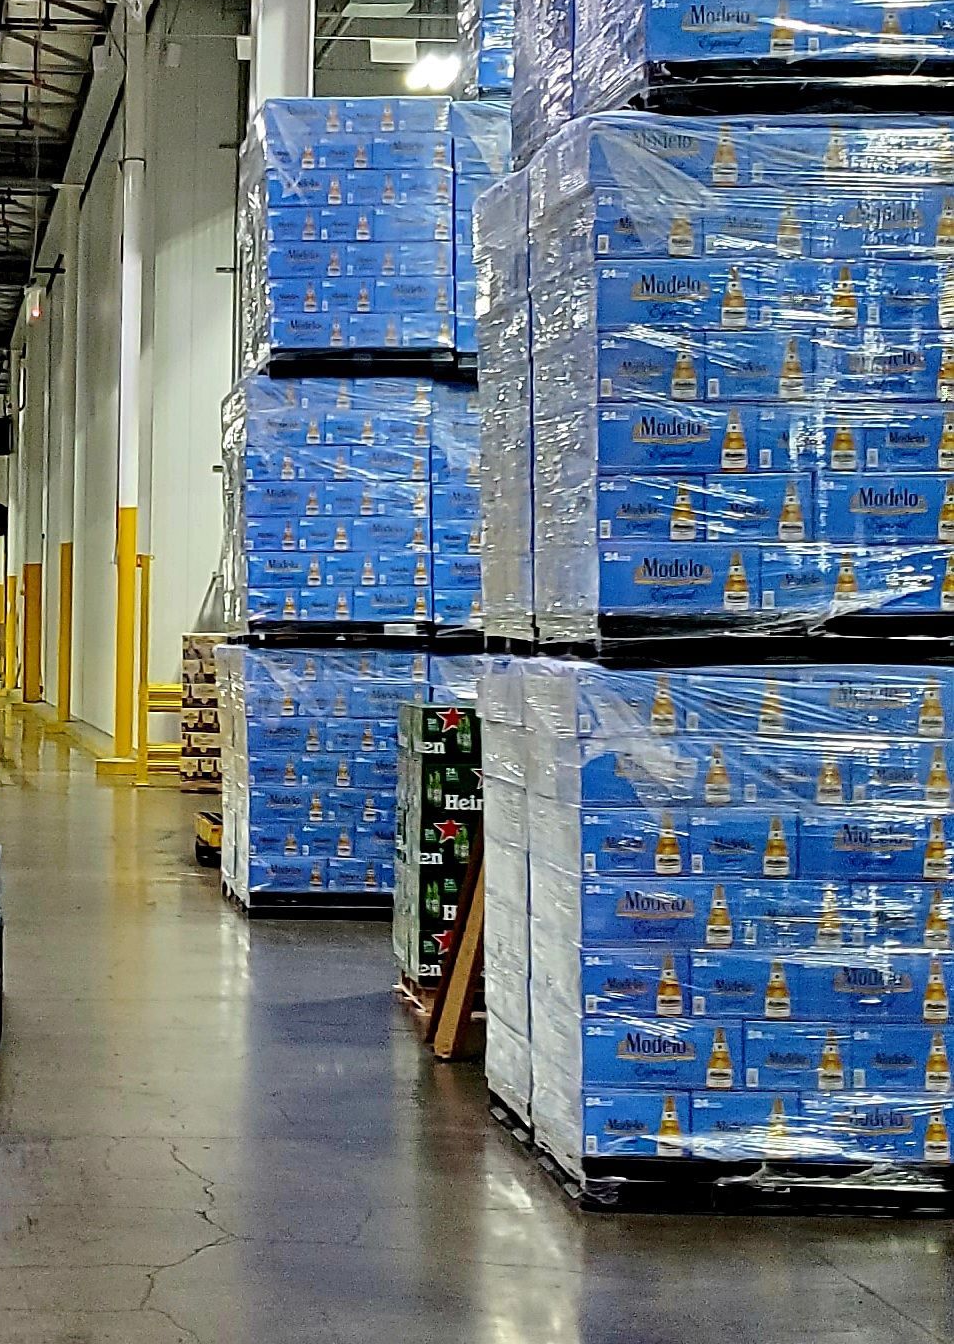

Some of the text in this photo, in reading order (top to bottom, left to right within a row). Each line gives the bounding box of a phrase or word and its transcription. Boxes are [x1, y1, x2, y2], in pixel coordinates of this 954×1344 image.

[651, 0, 666, 9] 24
[598, 197, 613, 206] 24
[601, 269, 616, 279] 24
[640, 273, 701, 295] Modelo
[601, 411, 617, 421] 24
[640, 415, 702, 436] Modelo
[599, 481, 615, 491] 24
[859, 487, 919, 507] Modelo
[643, 557, 704, 578] Modelo
[626, 1031, 688, 1055] Modelo
